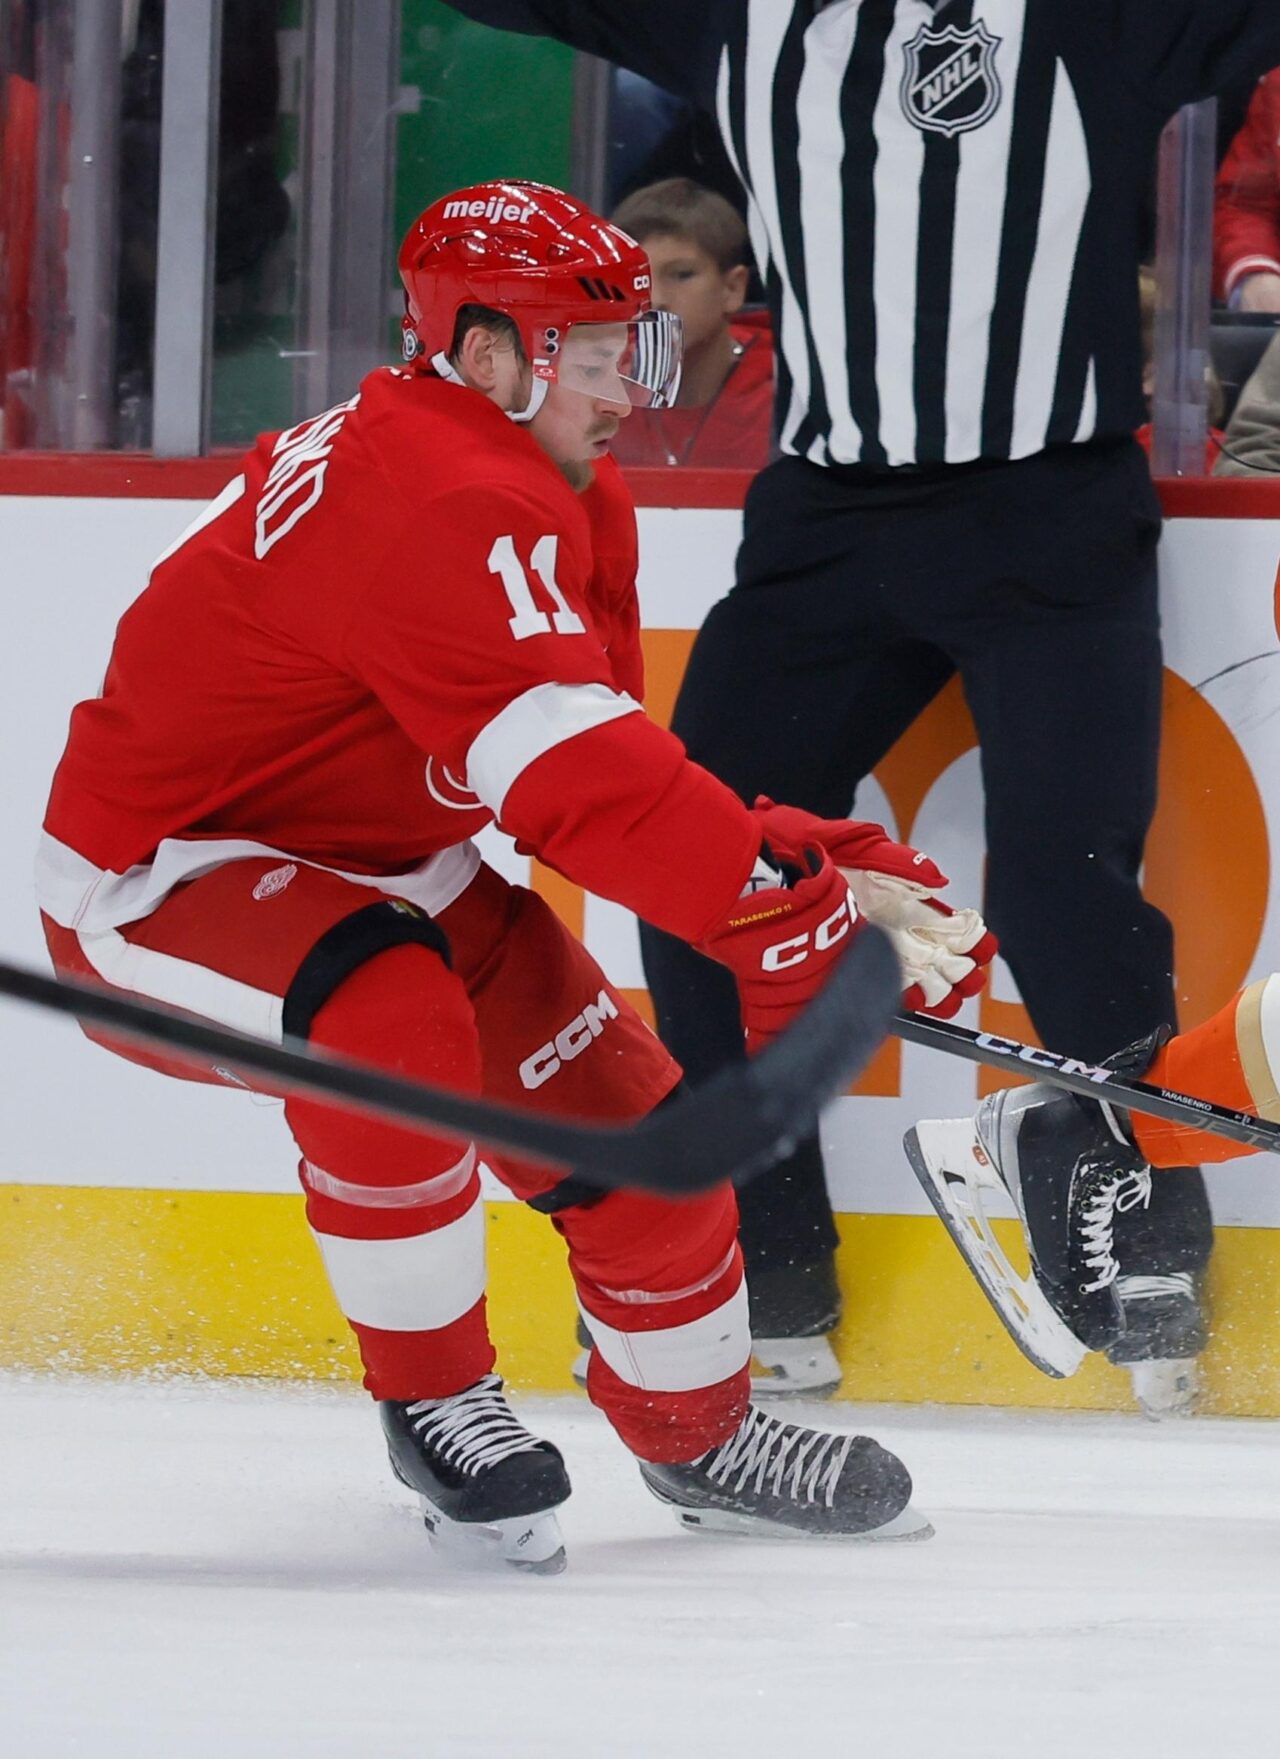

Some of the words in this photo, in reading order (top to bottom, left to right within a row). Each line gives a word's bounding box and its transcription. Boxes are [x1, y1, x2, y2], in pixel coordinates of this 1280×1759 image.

[922, 51, 980, 112] NHL
[442, 197, 532, 224] meijer
[487, 534, 587, 641] 11
[728, 907, 783, 928] TARASENKO
[519, 989, 619, 1089] CCM
[974, 1032, 1114, 1084] CCM
[1161, 1089, 1213, 1112] TARASENKO
[516, 1528, 534, 1548] CCM
